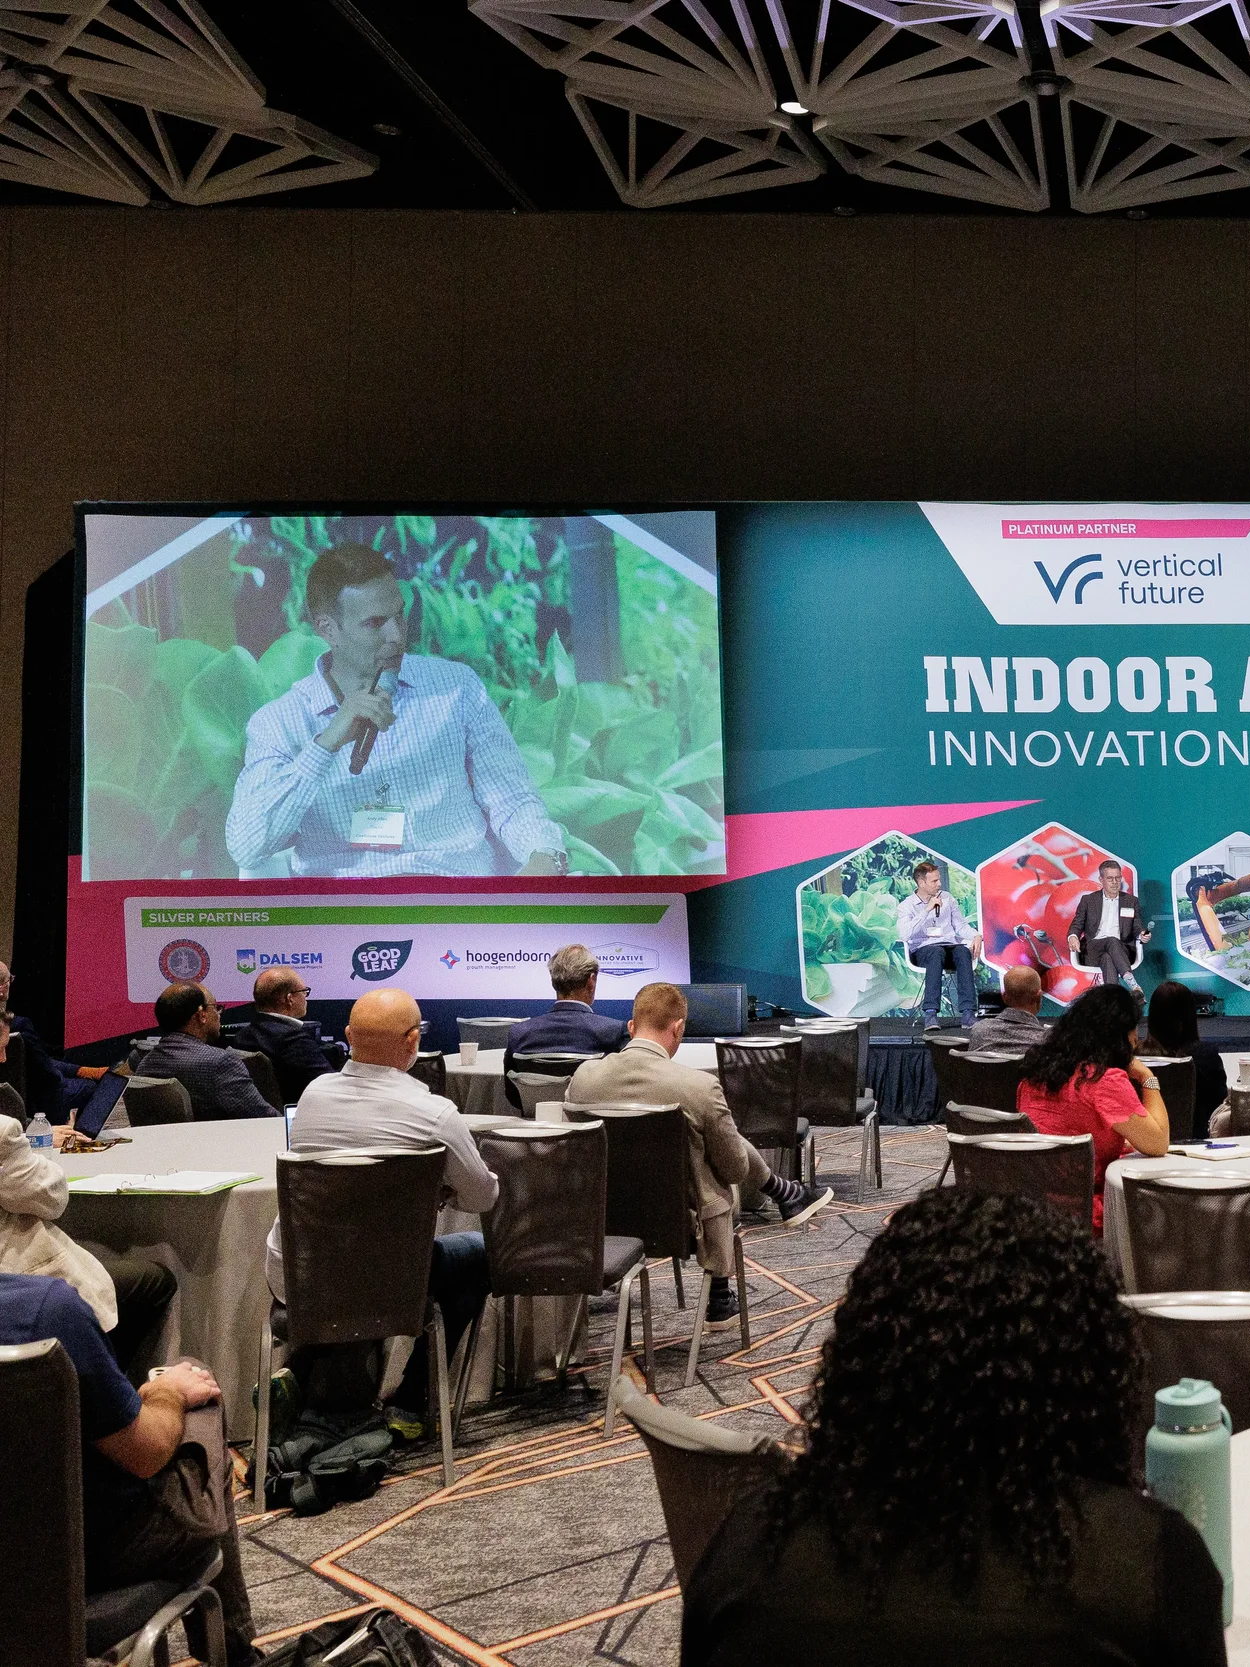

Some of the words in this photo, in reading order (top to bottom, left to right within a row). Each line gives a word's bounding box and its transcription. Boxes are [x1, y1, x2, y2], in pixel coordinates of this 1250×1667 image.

[1008, 523, 1075, 535] PLATINUM
[1077, 523, 1137, 535] PARTNER
[1117, 553, 1222, 577] vertical
[1118, 581, 1204, 604] future
[924, 656, 1217, 713] INDOOR
[928, 730, 1250, 767] INNOVATION
[149, 913, 195, 924] SILVER
[199, 912, 269, 924] PARTNERS
[260, 952, 323, 965] DALSEM
[357, 948, 401, 963] GOOD
[466, 949, 551, 965] hoogendoorn
[363, 959, 398, 973] LEAF
